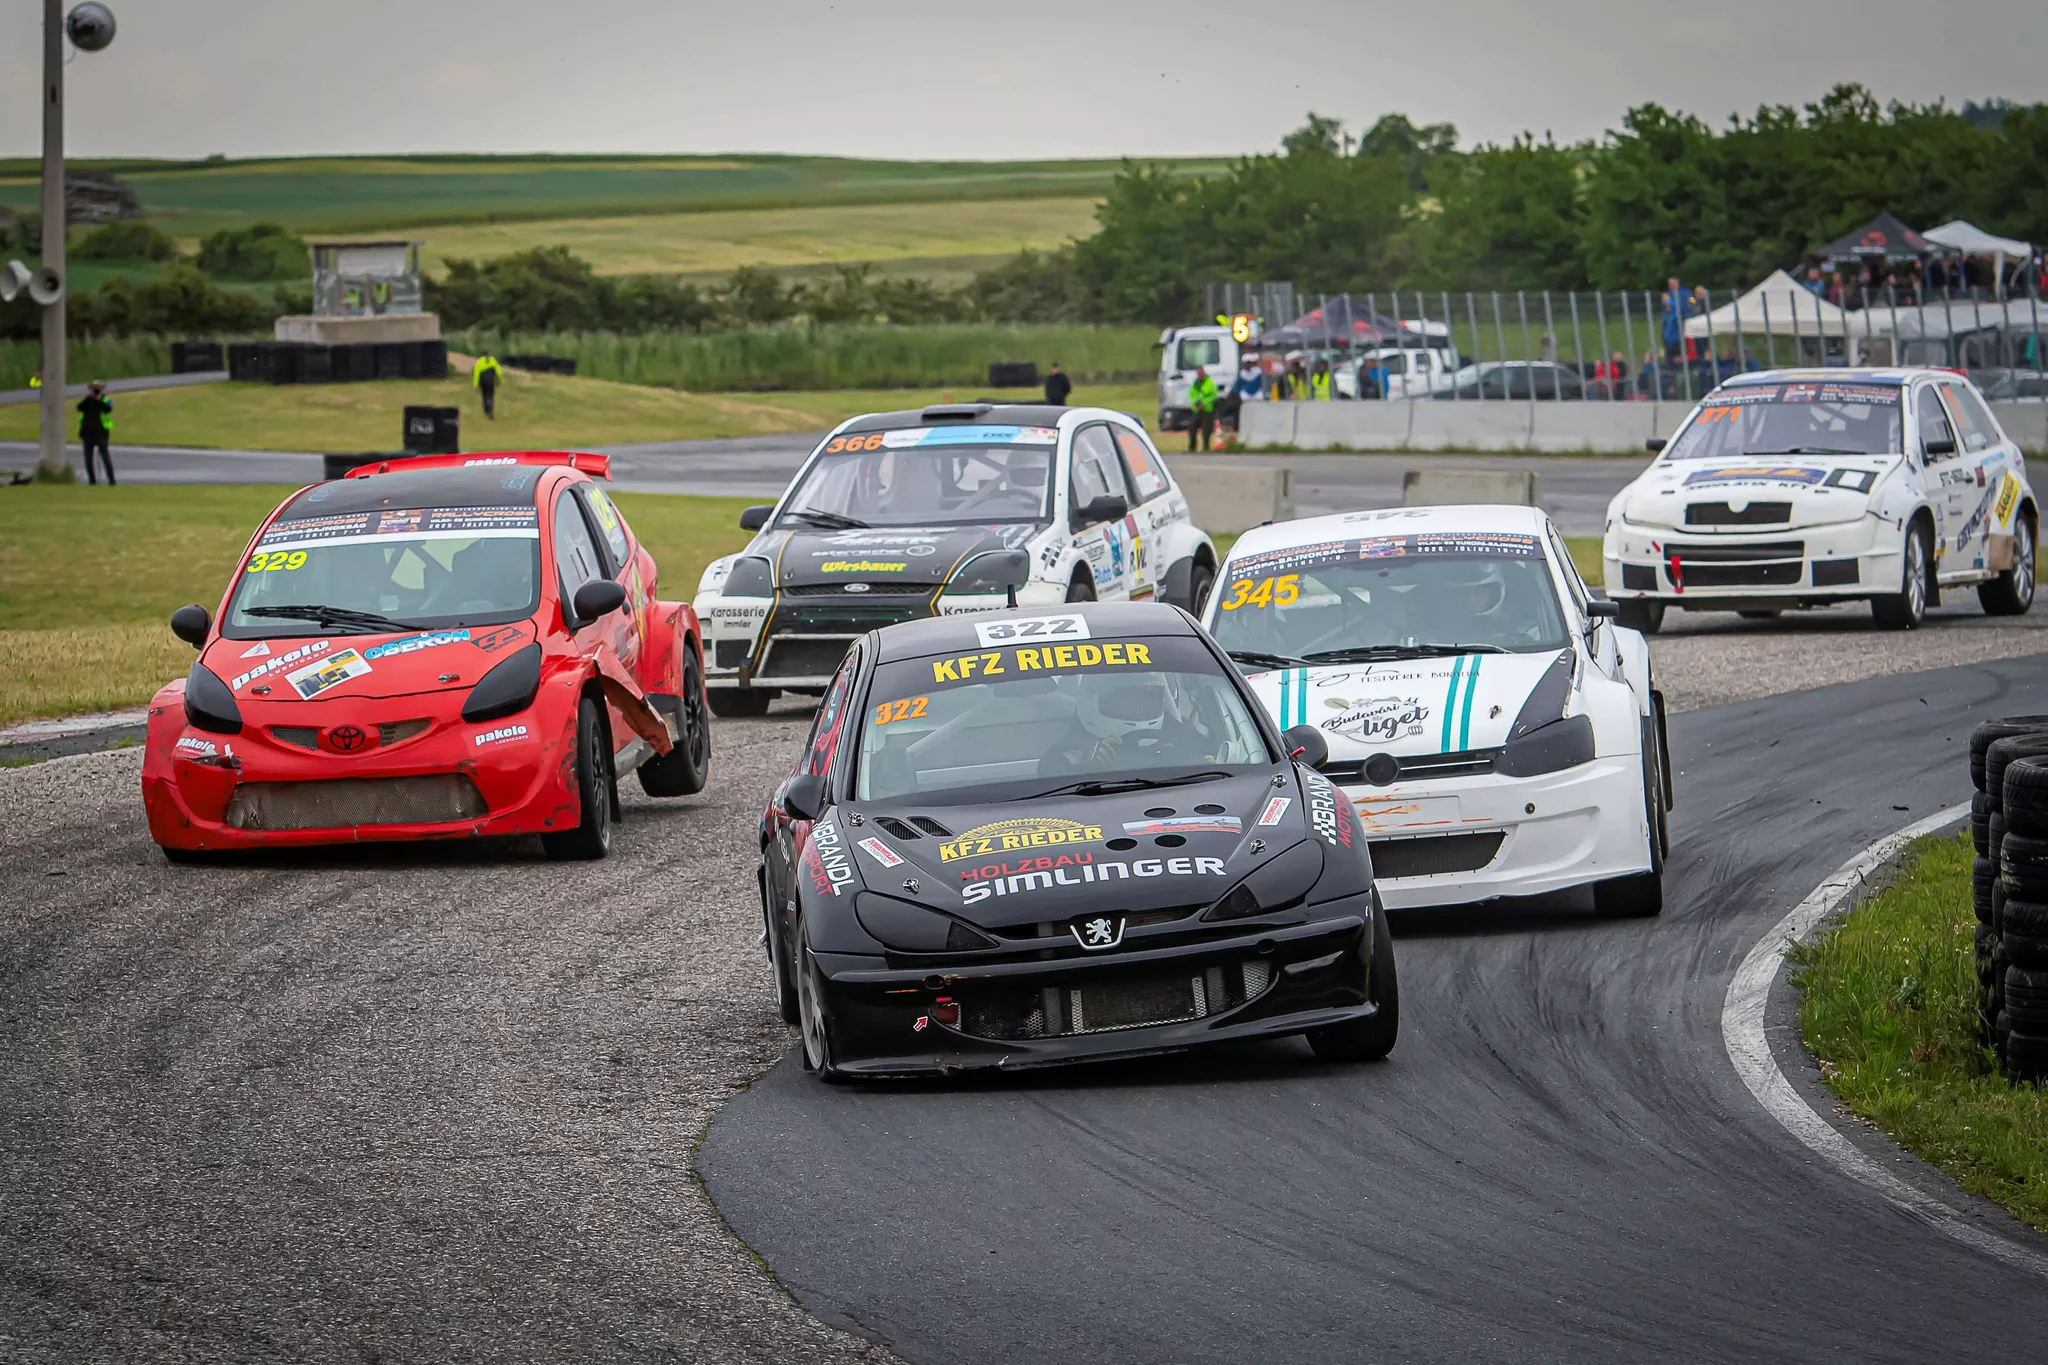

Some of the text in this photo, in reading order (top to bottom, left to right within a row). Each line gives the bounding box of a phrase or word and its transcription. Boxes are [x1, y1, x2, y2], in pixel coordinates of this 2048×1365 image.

[1696, 405, 1743, 423] 371
[827, 432, 884, 453] 366
[464, 457, 518, 467] pakelo
[245, 551, 308, 573] 329
[821, 560, 907, 573] Wiesbauer
[1221, 573, 1300, 611] 345
[710, 606, 765, 618] Karosserie
[986, 618, 1078, 640] 322
[231, 640, 330, 691] pakelo
[932, 643, 1152, 683] KFZ RIEDER
[875, 696, 929, 726] 322
[176, 737, 216, 751] pakelo
[475, 725, 527, 746] pakelo
[940, 826, 1105, 861] KFZ RIEDER
[812, 822, 855, 897] BRANDL
[960, 851, 1094, 881] HOLZBAU
[961, 856, 1228, 905] SIMLINGER
